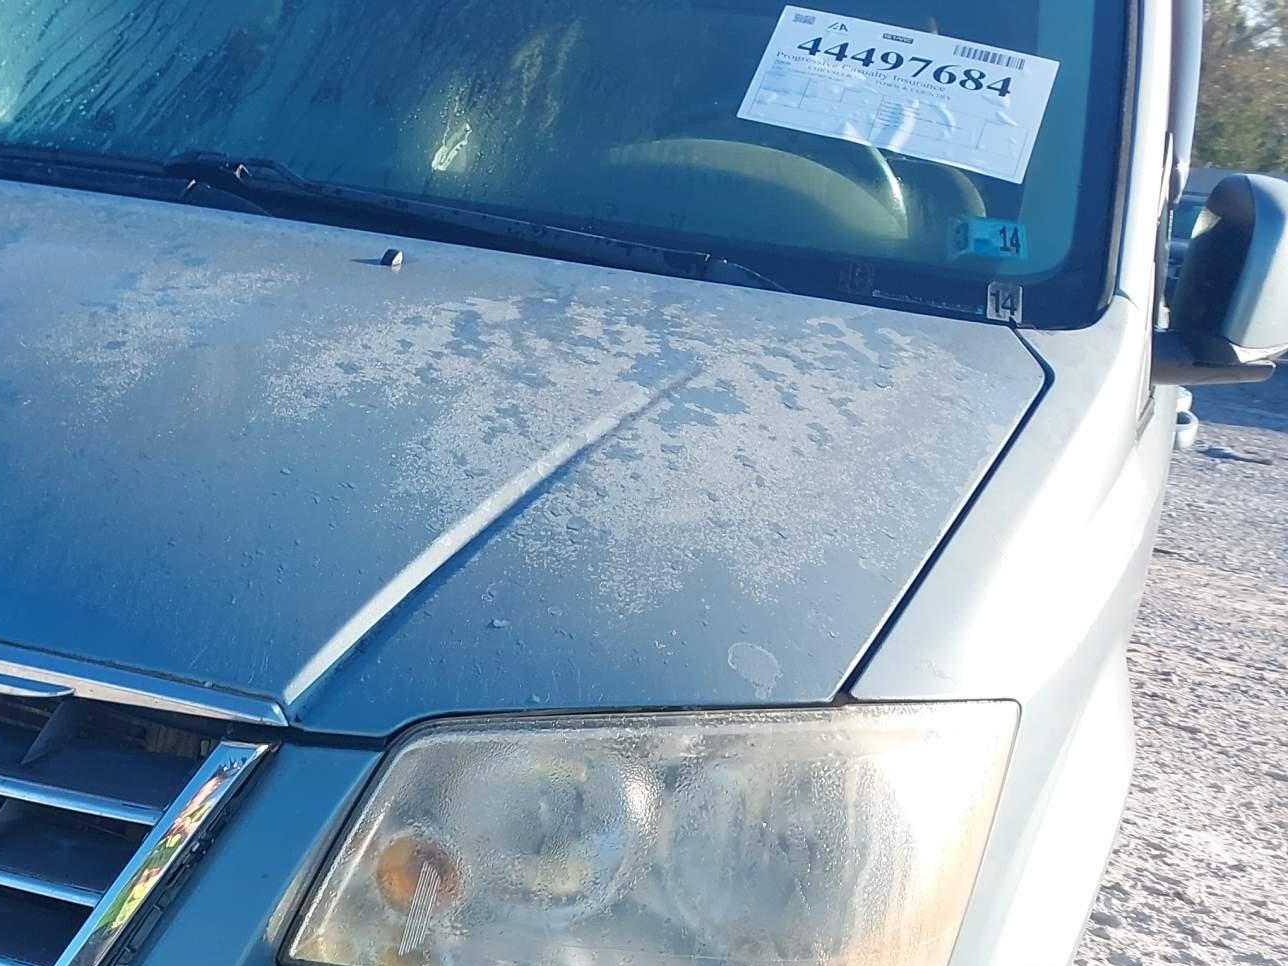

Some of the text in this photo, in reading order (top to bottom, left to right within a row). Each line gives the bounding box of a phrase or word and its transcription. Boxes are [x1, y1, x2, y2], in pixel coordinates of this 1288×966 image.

[776, 51, 838, 69] Progressive
[842, 64, 888, 80] Casualty
[893, 75, 946, 91] Insurance
[797, 37, 1012, 97] 44497684
[1000, 225, 1021, 253] 14
[990, 290, 1017, 316] 14
